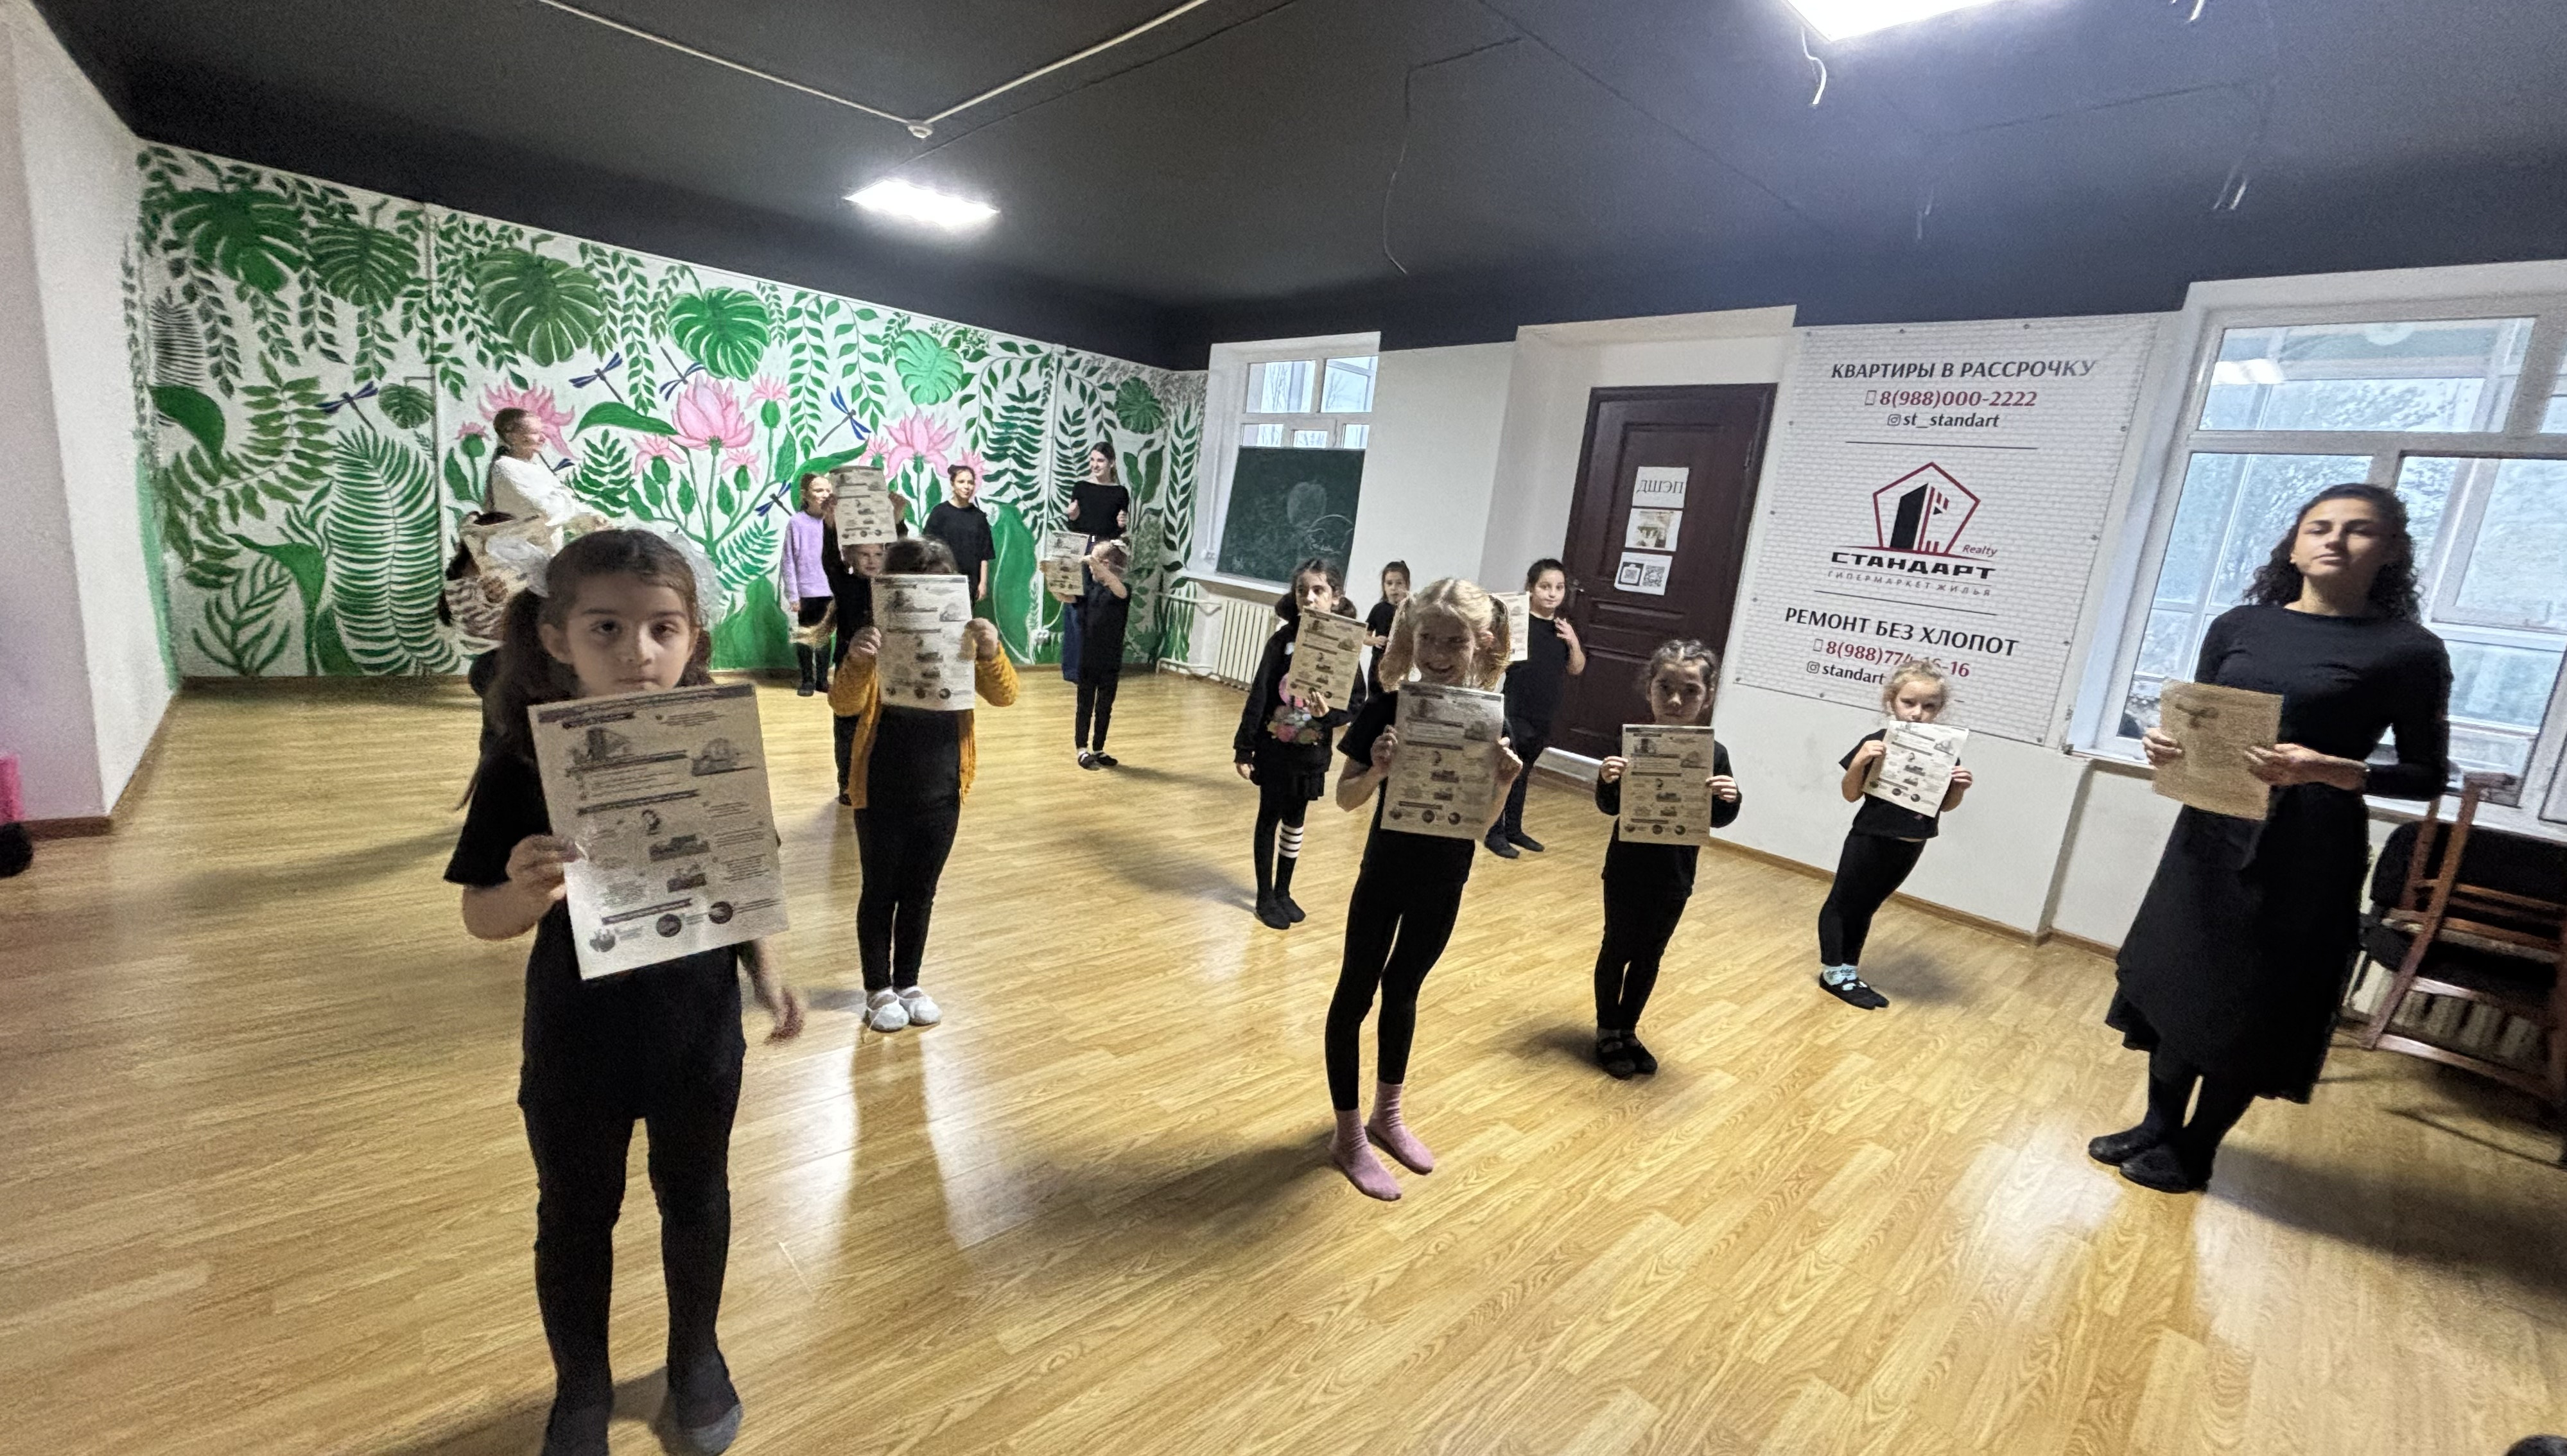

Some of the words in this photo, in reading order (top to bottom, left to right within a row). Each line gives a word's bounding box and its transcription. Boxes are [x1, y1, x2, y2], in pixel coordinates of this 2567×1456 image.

[1831, 363, 1935, 379] КВАРТИРЫ
[1941, 363, 1954, 377] В
[1960, 360, 2096, 377] РАССРОЧКУ
[1879, 390, 2037, 408] 8(988)000-2222
[1902, 413, 2000, 429] st_standart
[1637, 480, 1684, 494] ДШЭП
[1962, 544, 1997, 557] Realty
[1831, 551, 1996, 579] СТАНДАРТ
[1828, 570, 1931, 589] ГИПЕРМАРКЕТ
[1937, 584, 1990, 596] ЖИЛЬЯ
[1785, 607, 1870, 633] РЕМОНТ
[1875, 621, 1915, 640] БЕЗ
[1919, 627, 2019, 656] ХЛОПОТ
